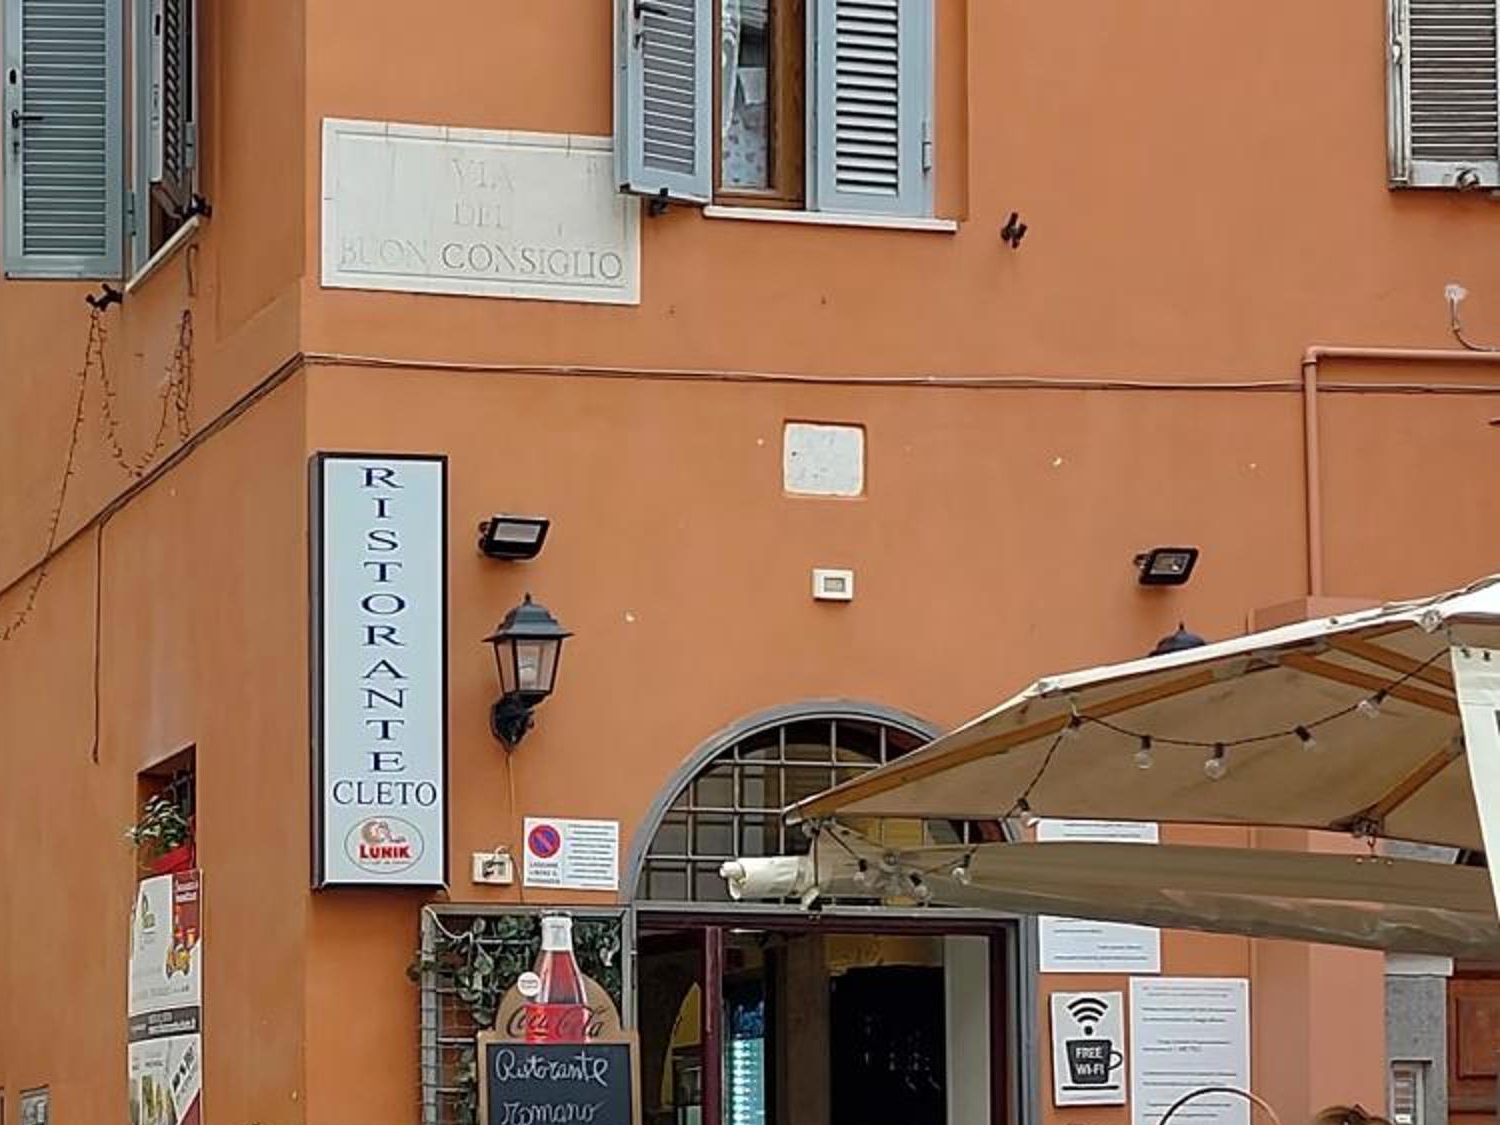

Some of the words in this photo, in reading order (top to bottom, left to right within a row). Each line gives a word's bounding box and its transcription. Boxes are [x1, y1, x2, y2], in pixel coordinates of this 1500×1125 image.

[451, 157, 516, 192] VIA
[340, 238, 428, 266] BUON
[441, 242, 623, 280] CONSIGLIO
[359, 466, 409, 774] RISTORANTE
[332, 780, 438, 808] CLETO
[1075, 1047, 1104, 1059] FREE
